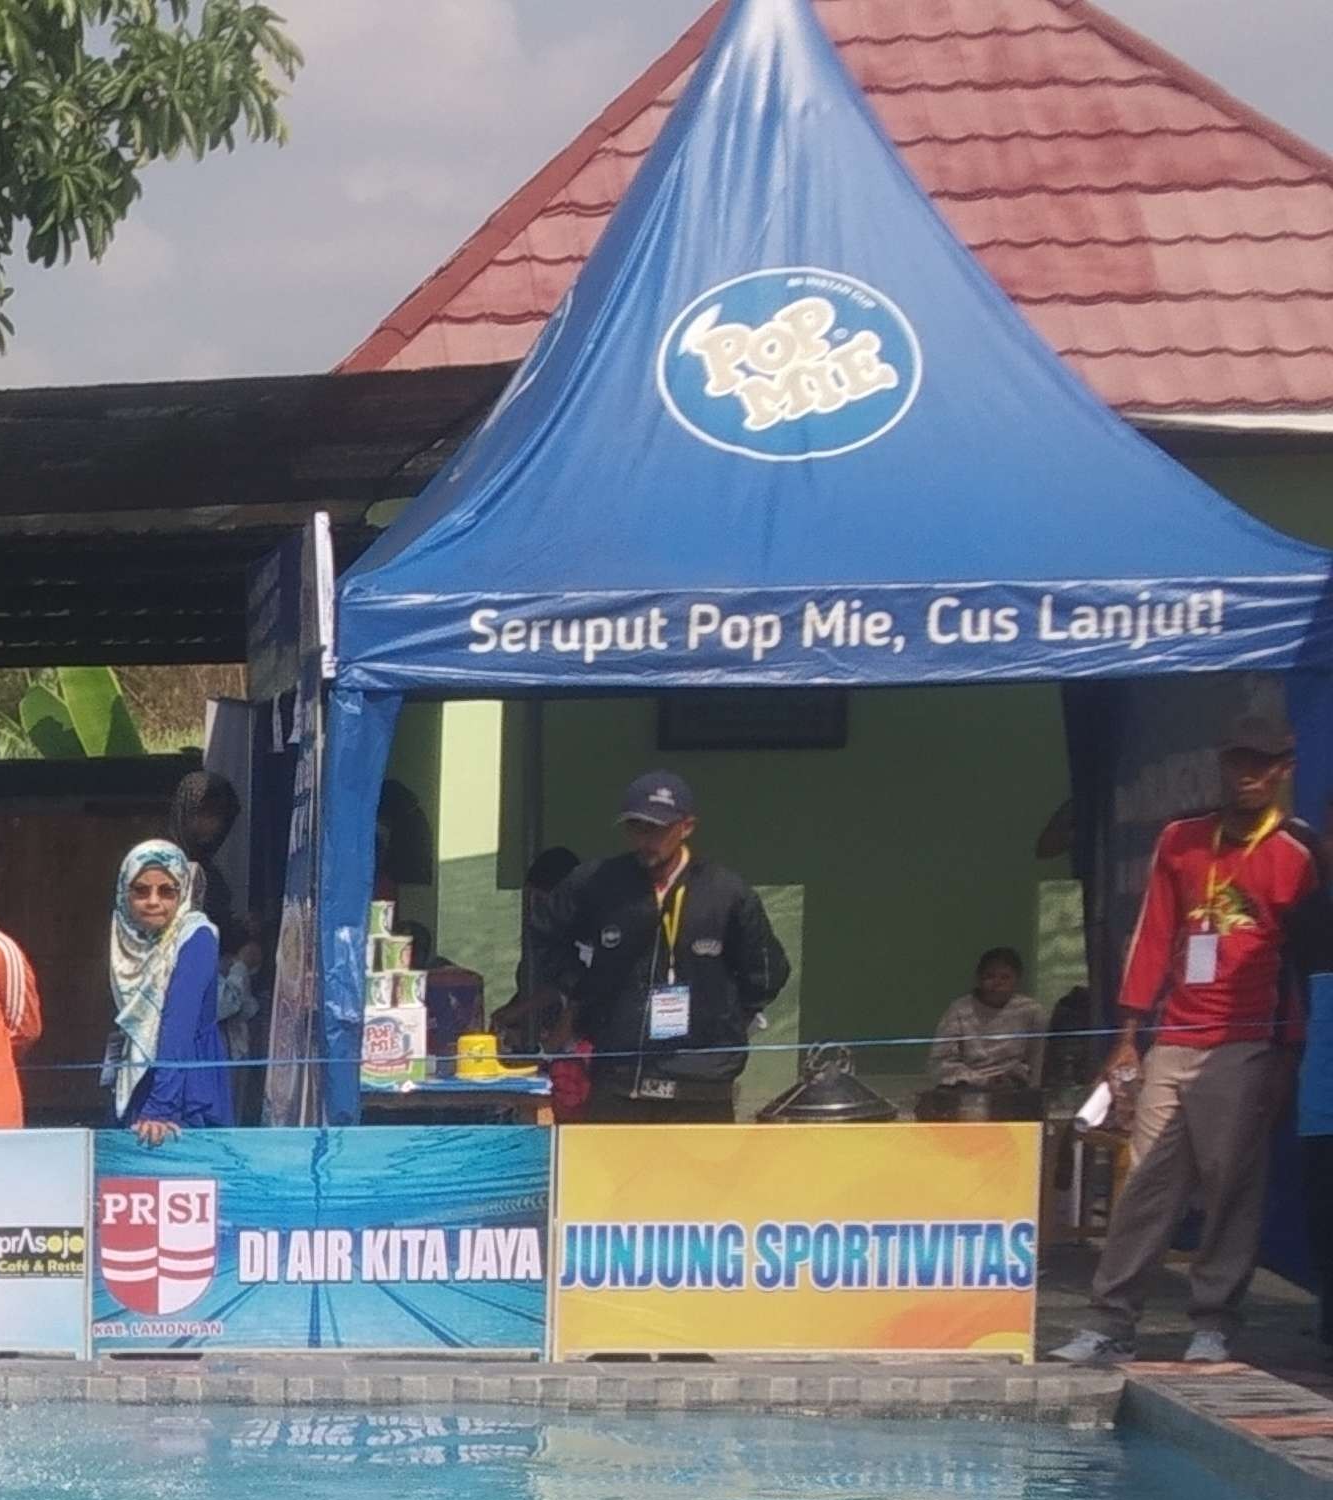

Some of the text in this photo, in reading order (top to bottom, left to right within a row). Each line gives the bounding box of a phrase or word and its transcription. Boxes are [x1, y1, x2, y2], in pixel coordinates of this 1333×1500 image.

[691, 297, 836, 397] POP
[735, 330, 899, 432] MIE
[469, 588, 1224, 664] Seruput Pop Mie, Cus Lanjut!
[103, 1192, 210, 1225] PRSI
[238, 1228, 542, 1282] DI AIR KITA JAYA
[560, 1222, 1035, 1288] JUNJUNG SPORTIVITAS
[133, 1323, 222, 1337] LAMONGAN
